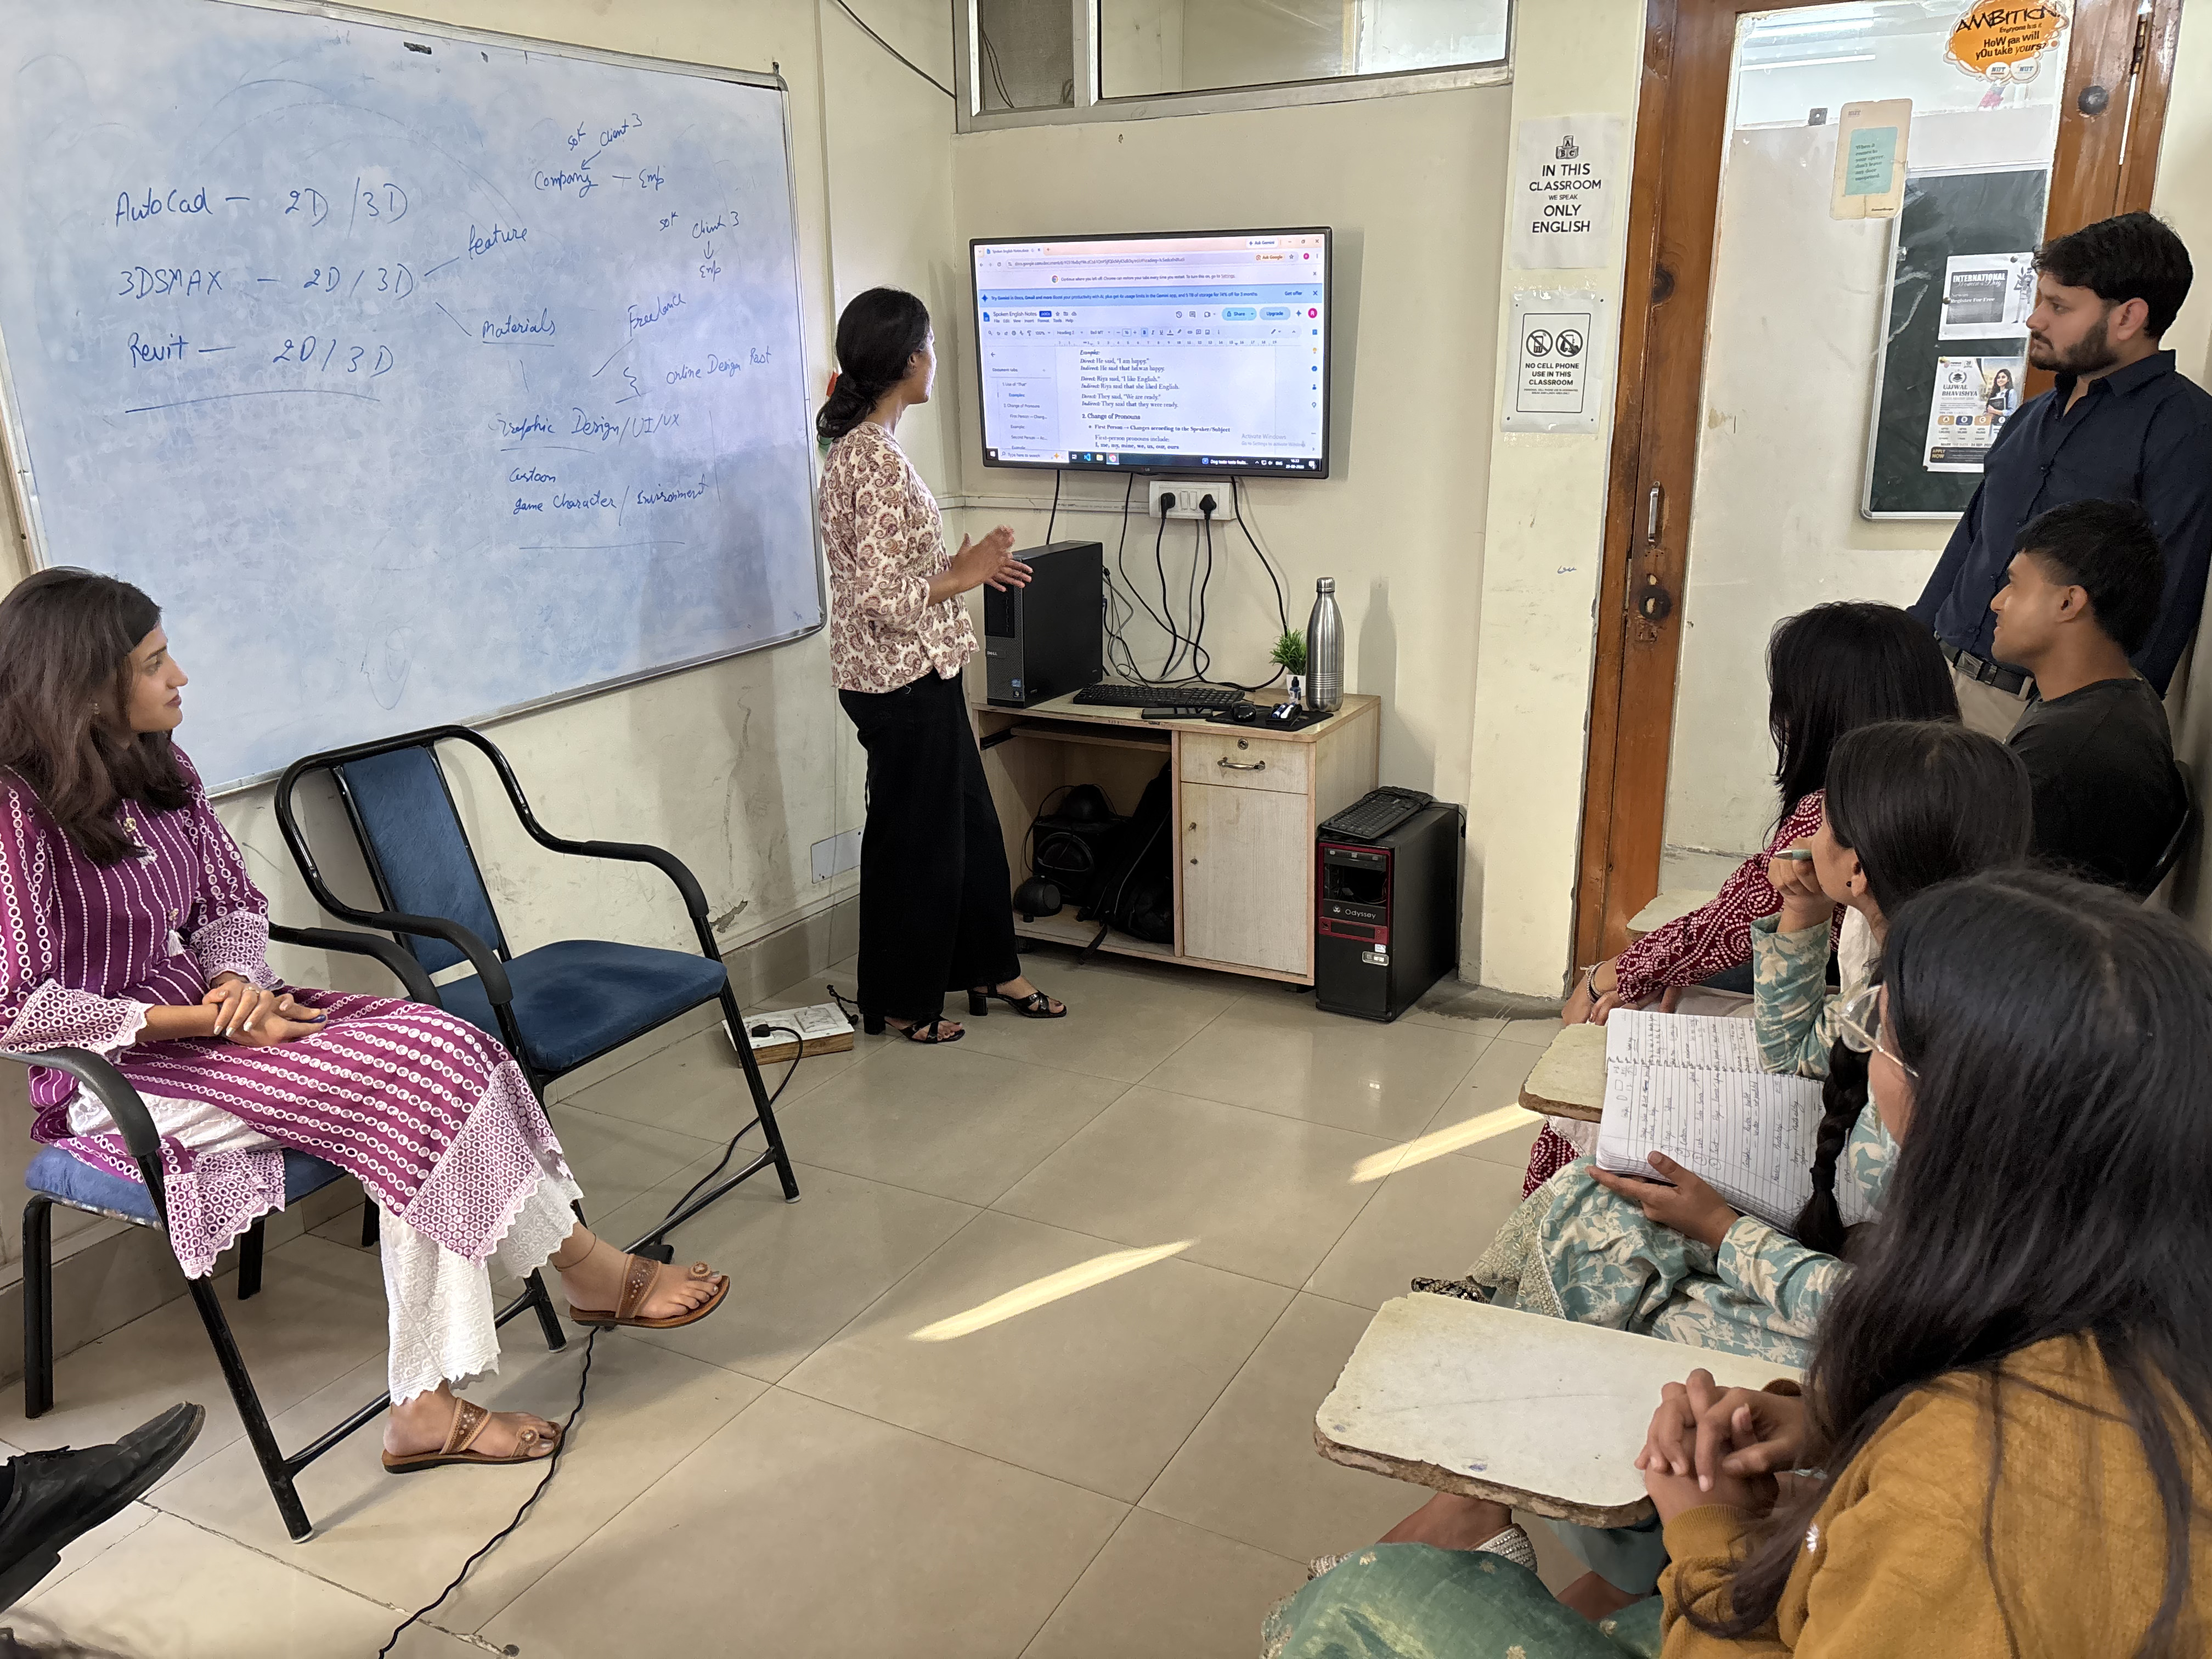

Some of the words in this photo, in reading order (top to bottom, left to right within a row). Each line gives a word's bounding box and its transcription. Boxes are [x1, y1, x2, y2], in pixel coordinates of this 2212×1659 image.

[2000, 25, 2026, 33] Everyone
[600, 119, 629, 146] Client
[1542, 165, 1555, 176] IN
[1561, 163, 1590, 176] THIS
[534, 165, 599, 198] Company
[1530, 179, 1601, 191] CLASSROOM
[285, 188, 329, 227] 2D
[1544, 204, 1582, 216] ONLY
[1532, 221, 1590, 233] ENGLISH
[118, 267, 223, 299] 3DSMAX
[303, 267, 341, 293] 2D
[1953, 273, 2005, 283] INTERNATIONAL
[127, 332, 189, 368] Revit
[707, 354, 741, 377] Design
[1345, 909, 1376, 919] Odyssey
